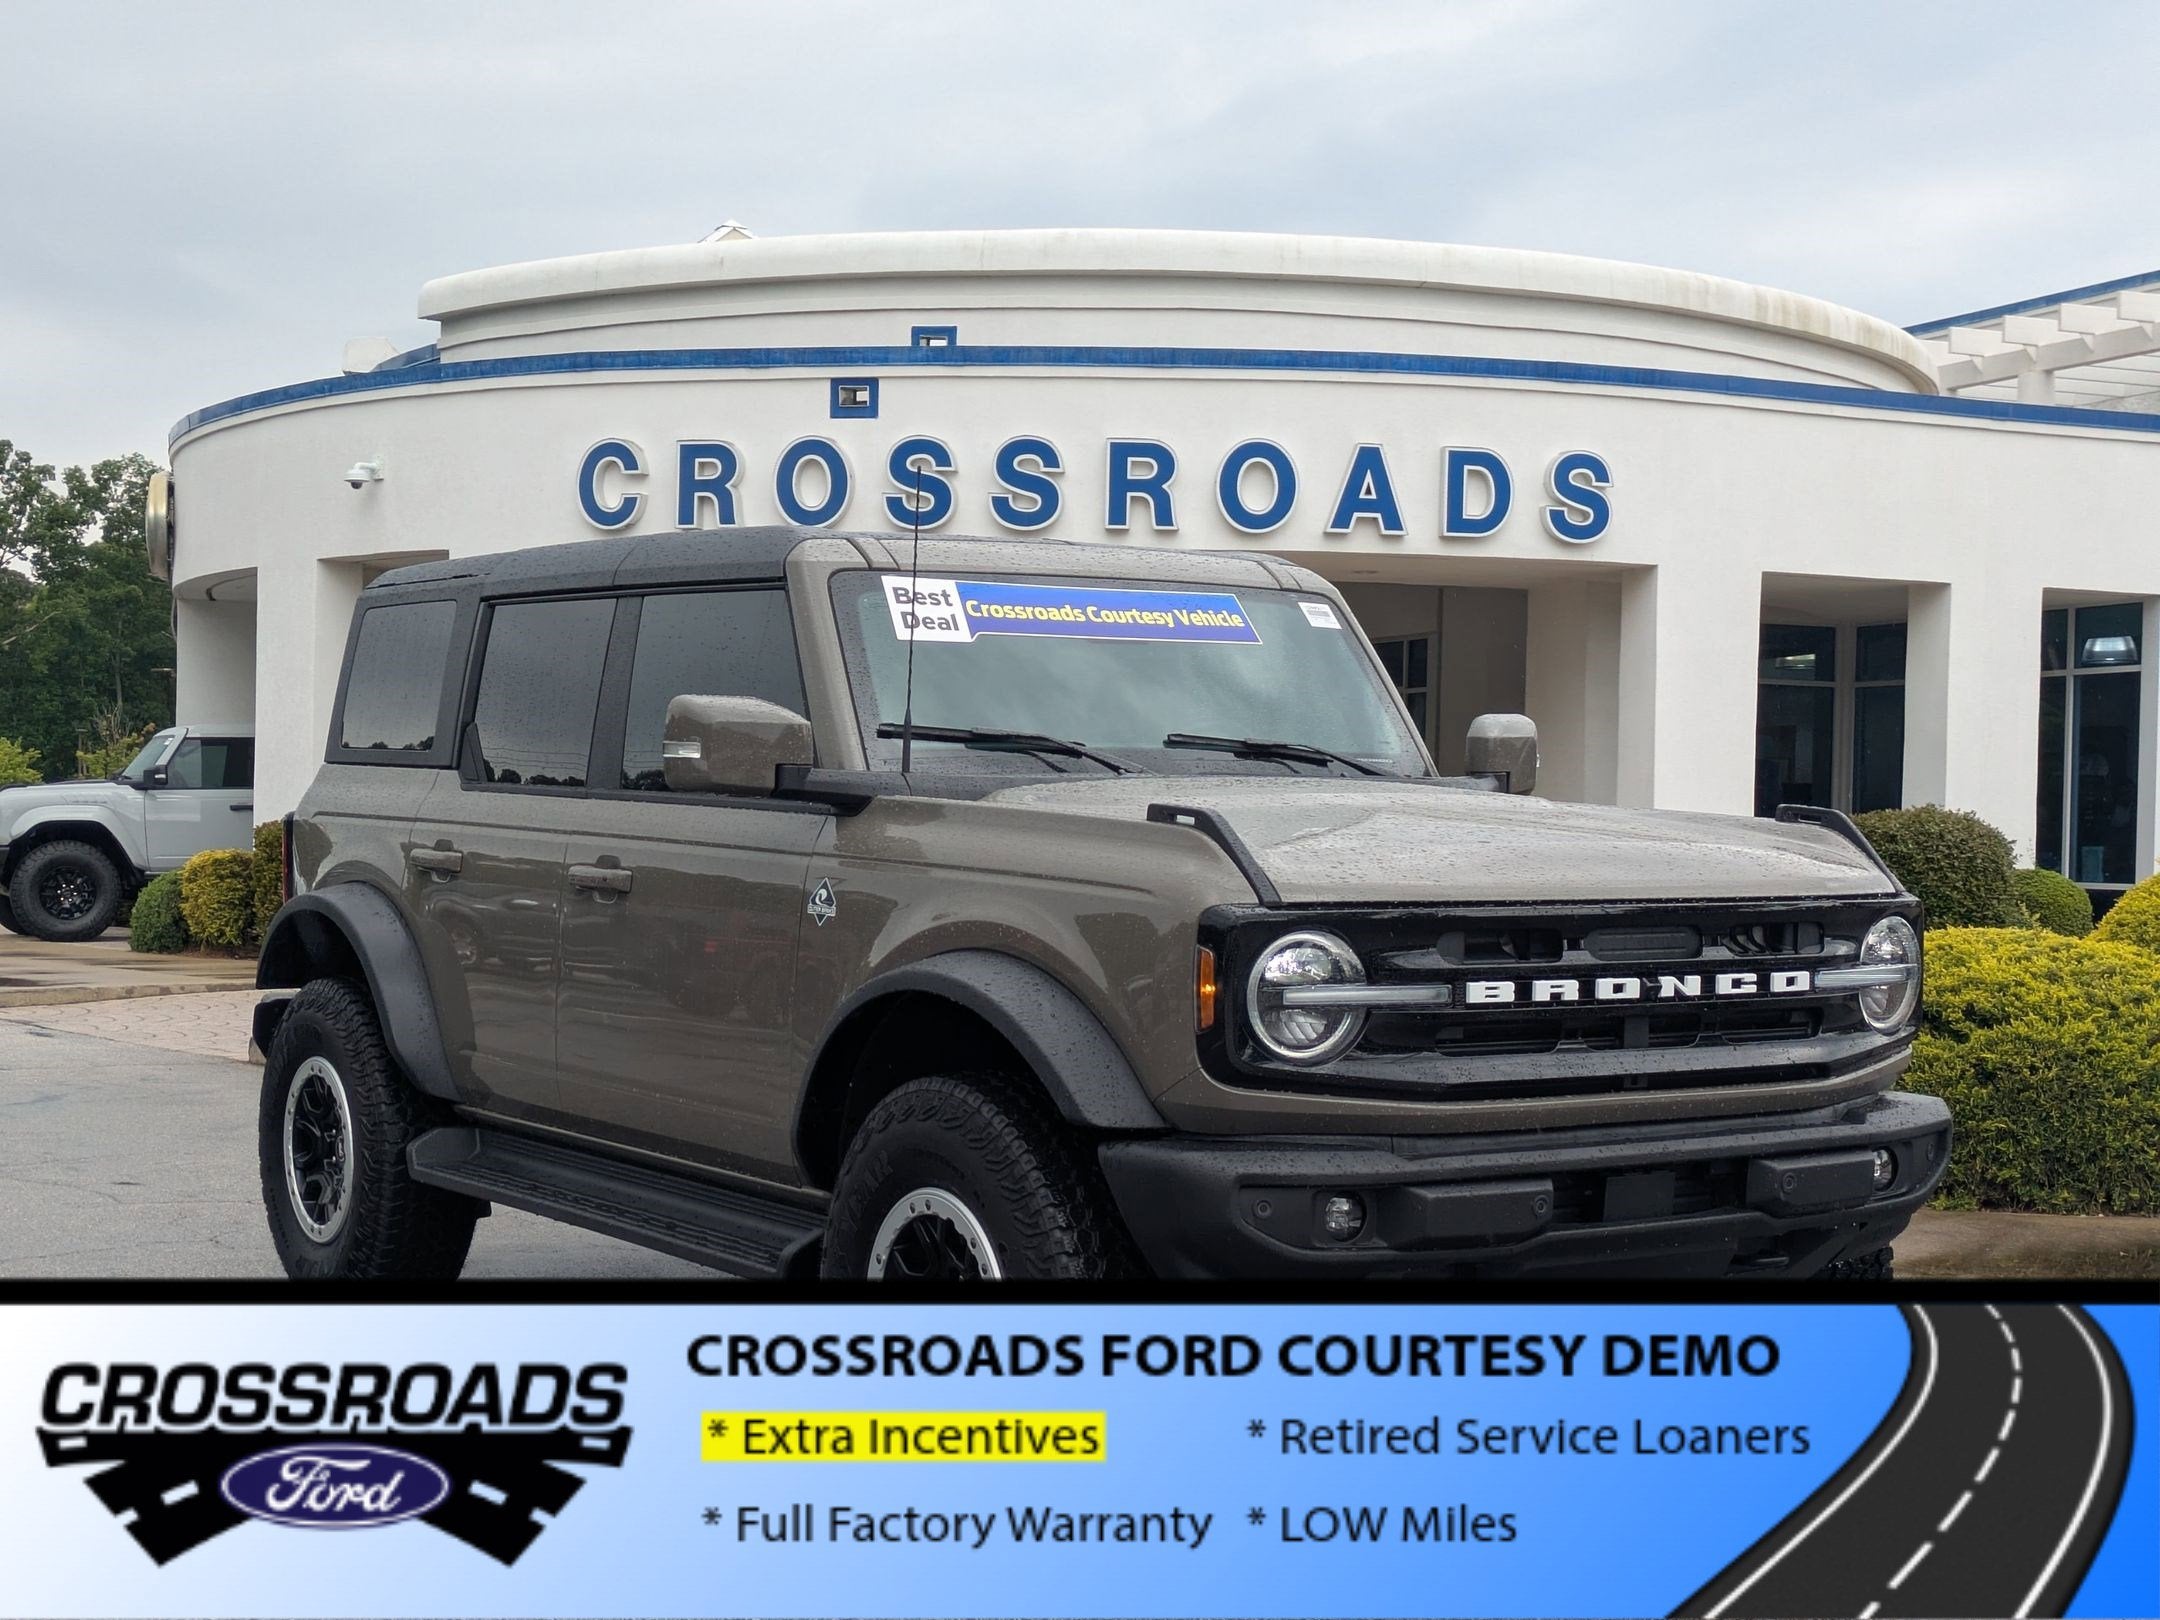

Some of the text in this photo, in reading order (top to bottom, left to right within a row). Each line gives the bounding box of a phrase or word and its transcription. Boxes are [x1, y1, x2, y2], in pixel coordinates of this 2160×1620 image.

[579, 436, 1612, 542] CROSSROADS
[892, 586, 954, 607] Best
[900, 611, 960, 631] Deal
[965, 599, 1246, 628] Crossroads Courtesy Vehicle
[1466, 970, 1811, 1004] BRONCO
